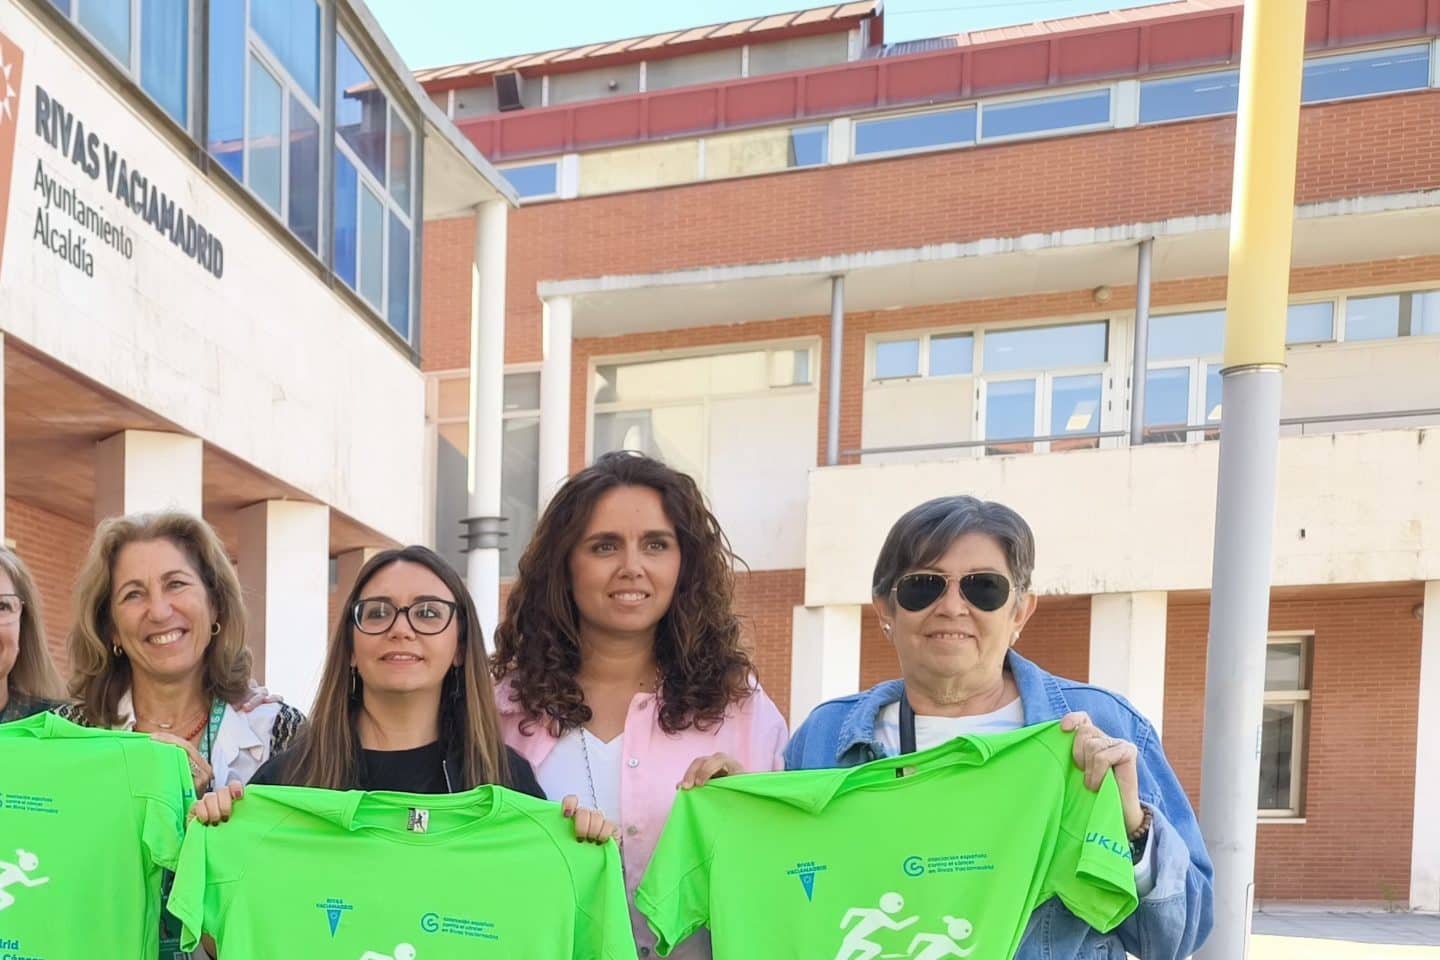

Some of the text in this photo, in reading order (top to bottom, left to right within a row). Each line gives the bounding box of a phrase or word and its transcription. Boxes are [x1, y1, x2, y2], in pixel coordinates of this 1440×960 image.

[33, 158, 133, 260] Ayuntamiento
[35, 84, 224, 279] RIVAS VACIAMADRID
[33, 207, 94, 278] Alcaldía
